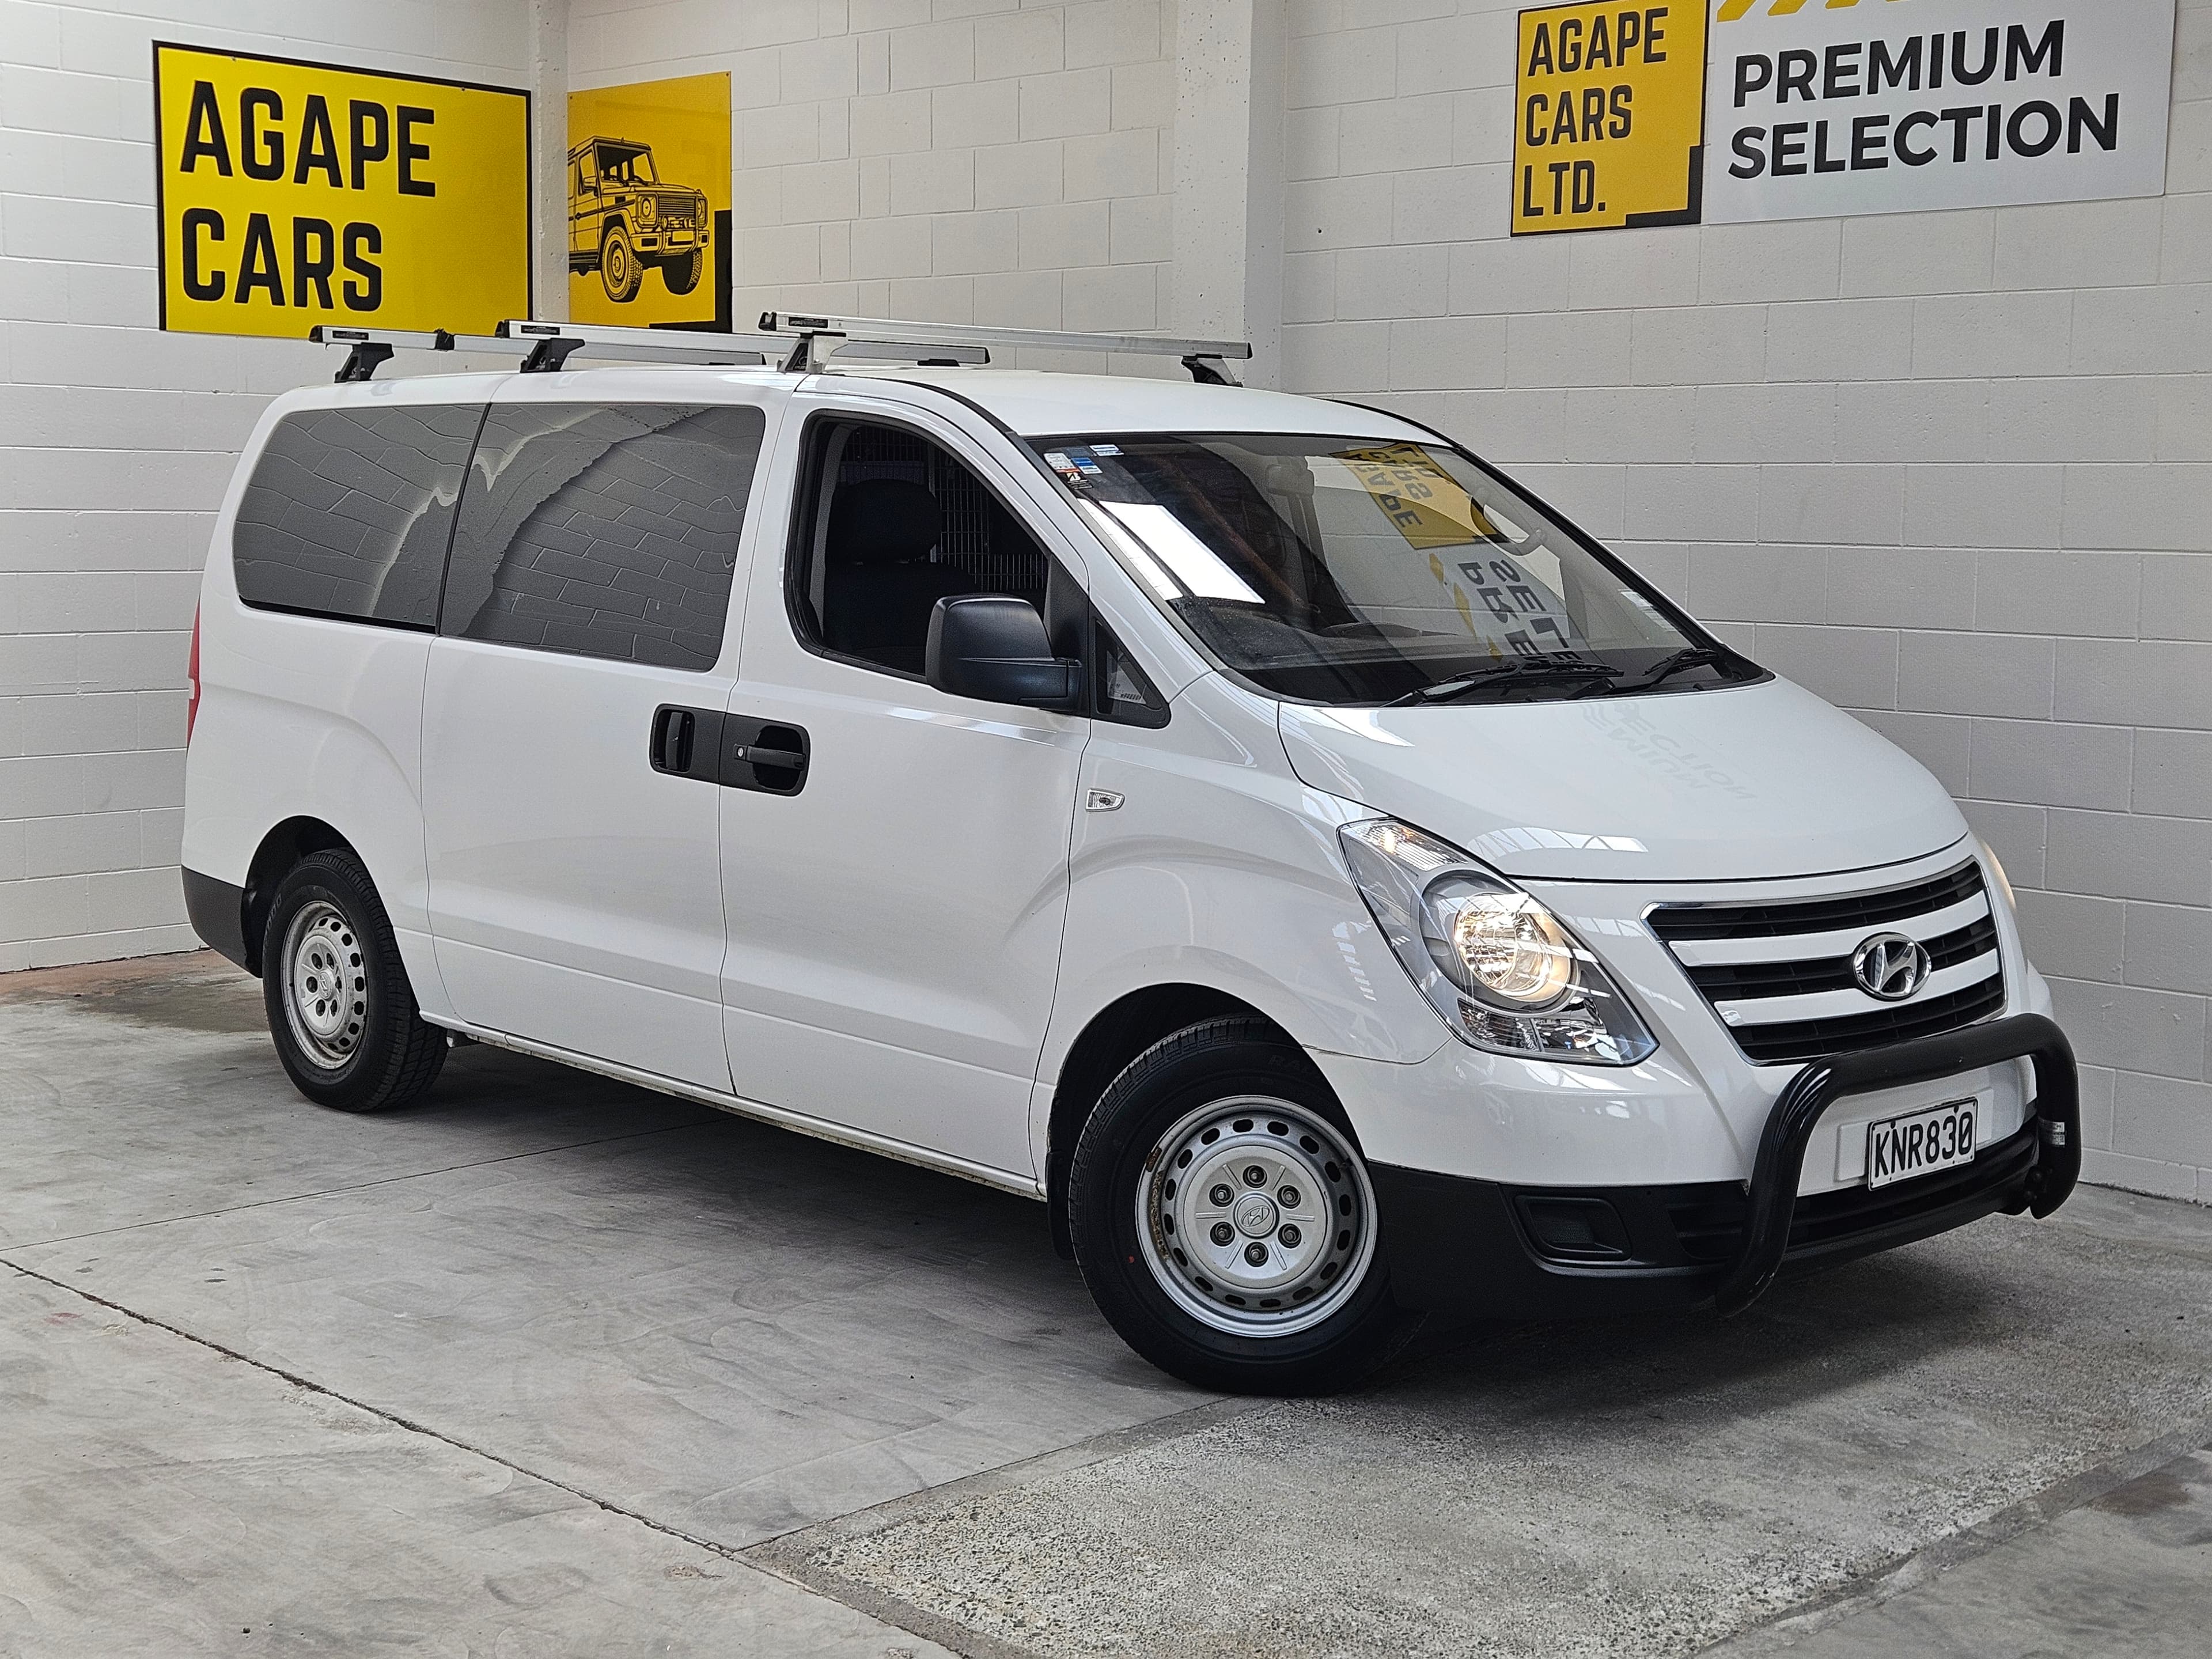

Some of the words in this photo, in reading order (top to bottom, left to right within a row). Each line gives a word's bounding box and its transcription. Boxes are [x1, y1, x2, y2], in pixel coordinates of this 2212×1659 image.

[1527, 7, 1668, 77] AGAPE
[1733, 19, 2065, 108] PREMIUM
[180, 80, 436, 198] AGAPE
[1525, 85, 1633, 147] CARS
[1728, 93, 2119, 179] SELECTION
[1522, 160, 1606, 217] LTD.
[182, 207, 382, 312] CARS
[1874, 1111, 1973, 1178] KNR830
